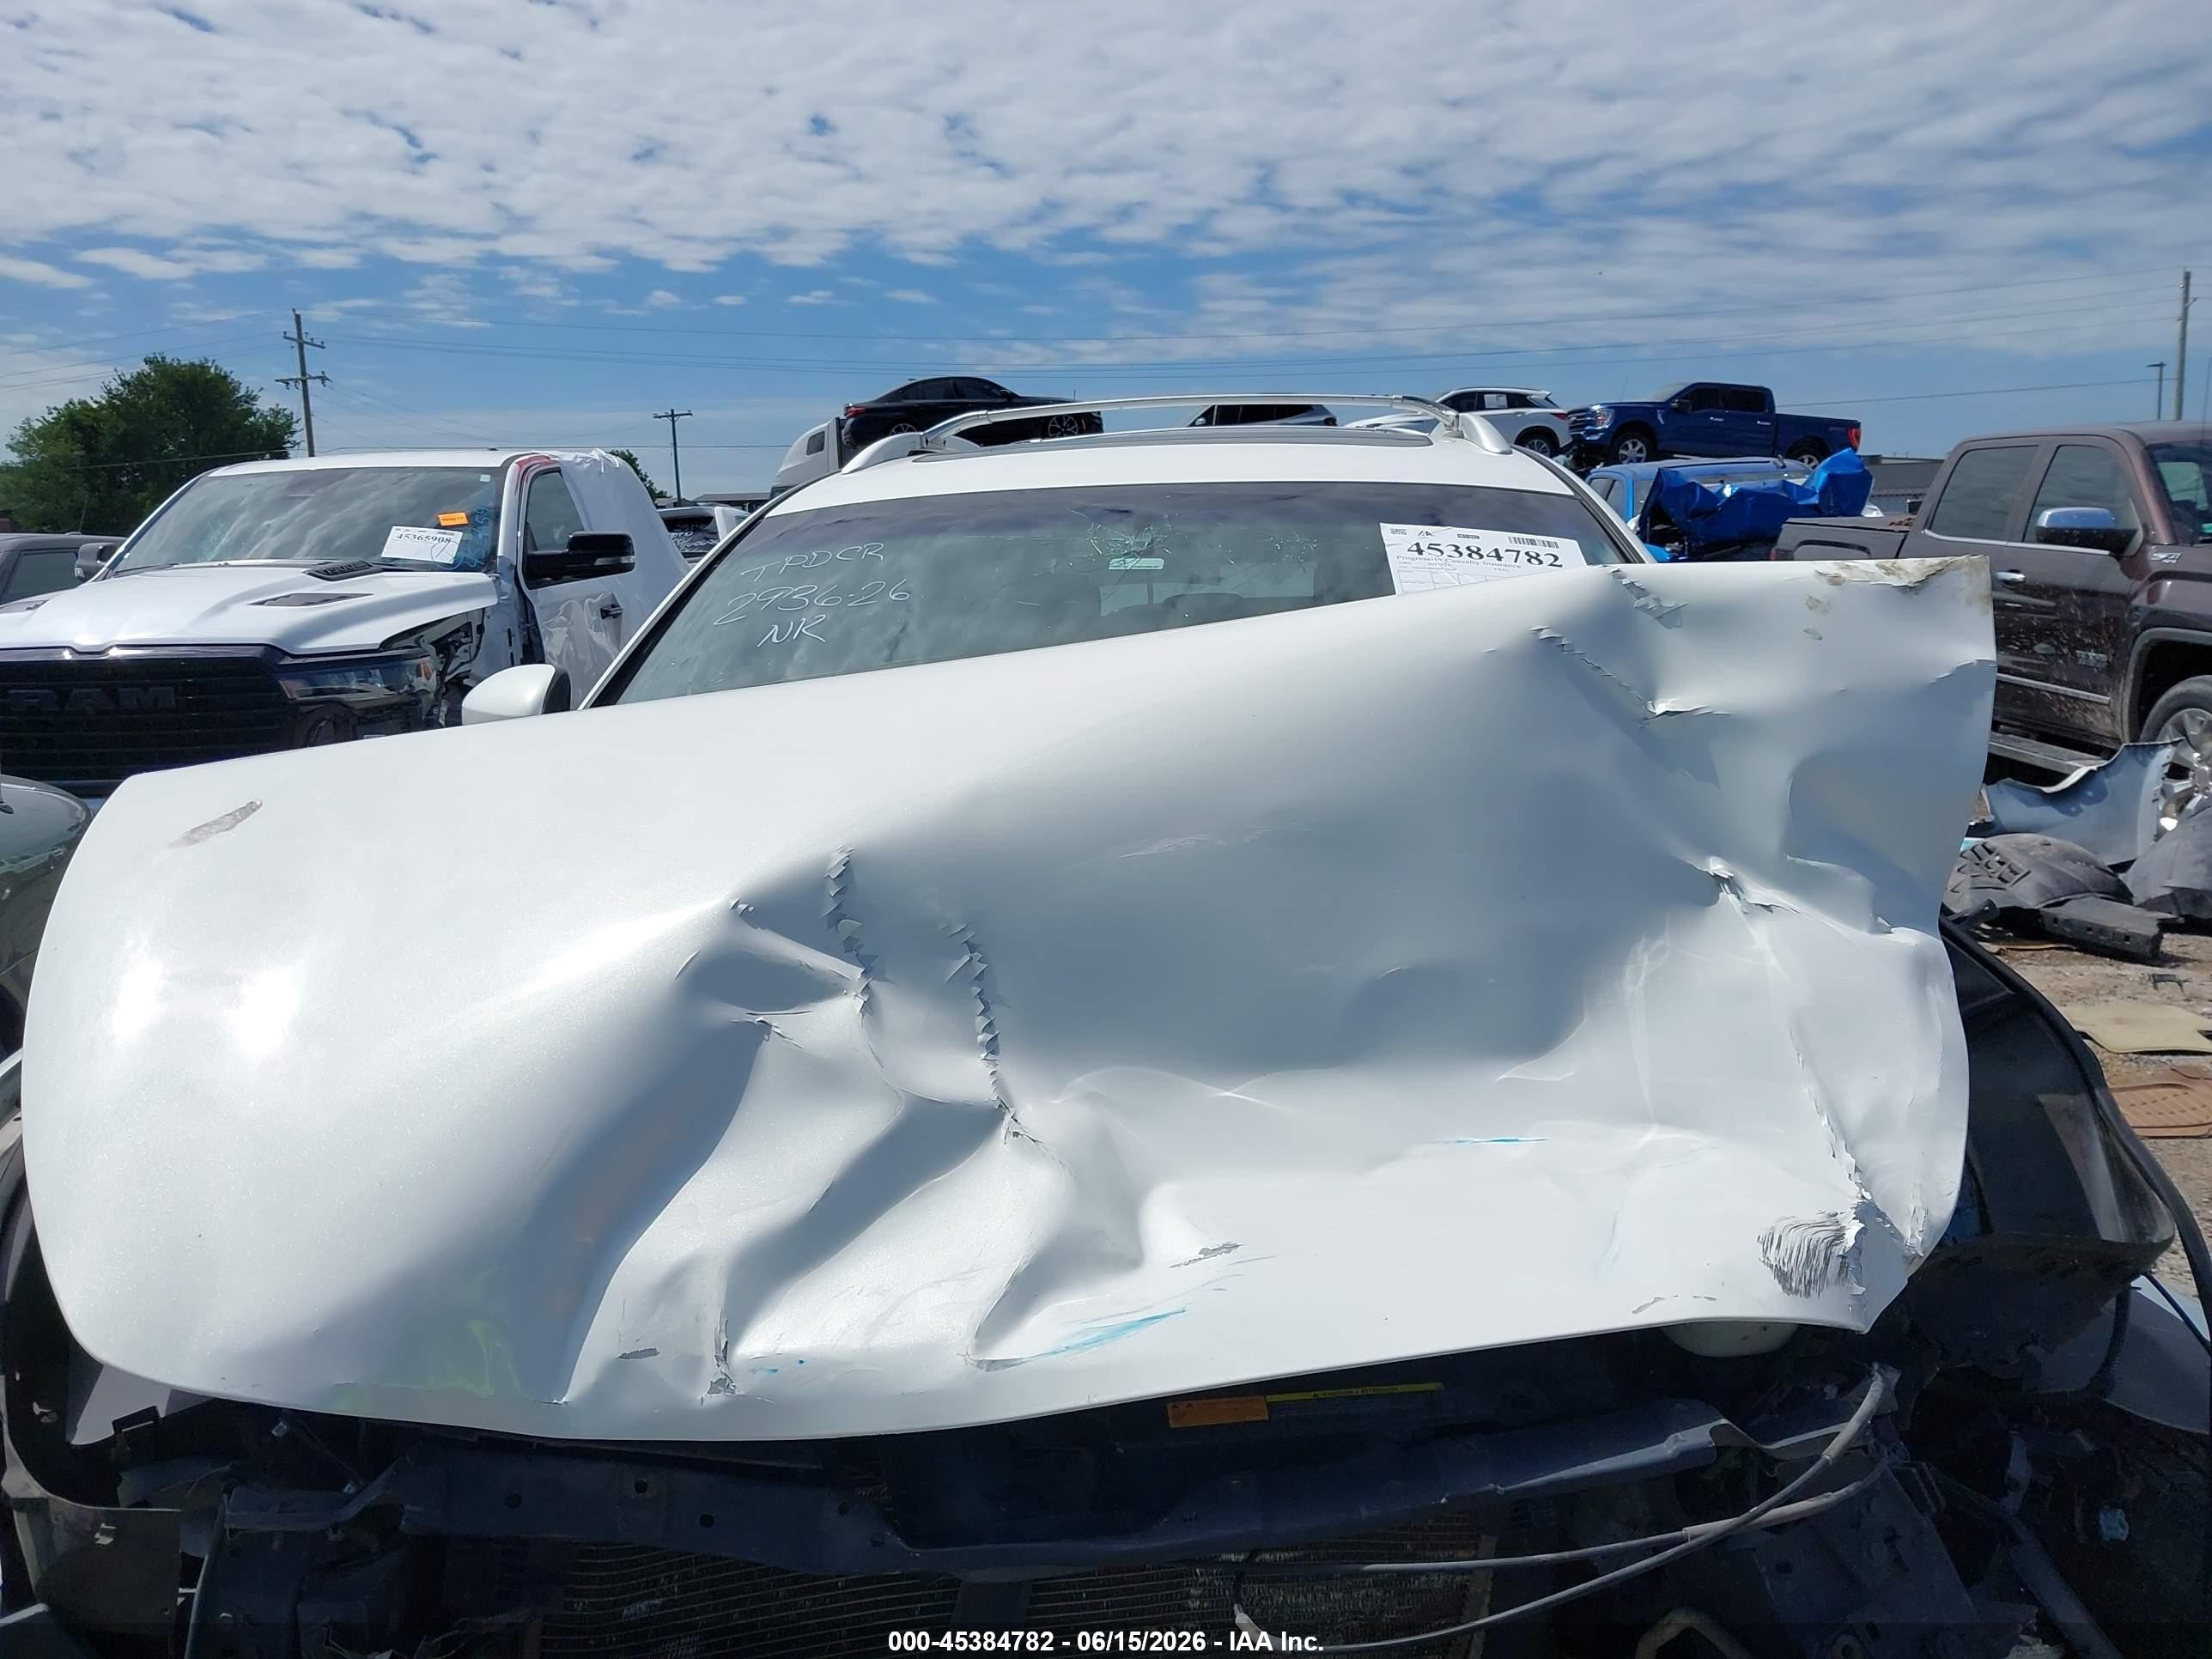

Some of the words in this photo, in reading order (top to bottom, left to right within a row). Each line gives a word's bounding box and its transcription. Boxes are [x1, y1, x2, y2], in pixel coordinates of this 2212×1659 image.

[396, 532, 452, 544] 45365908
[739, 543, 884, 582] TPDCR
[1407, 542, 1563, 568] 45384782
[1482, 561, 1522, 569] Insurance
[8, 688, 177, 711] RAM
